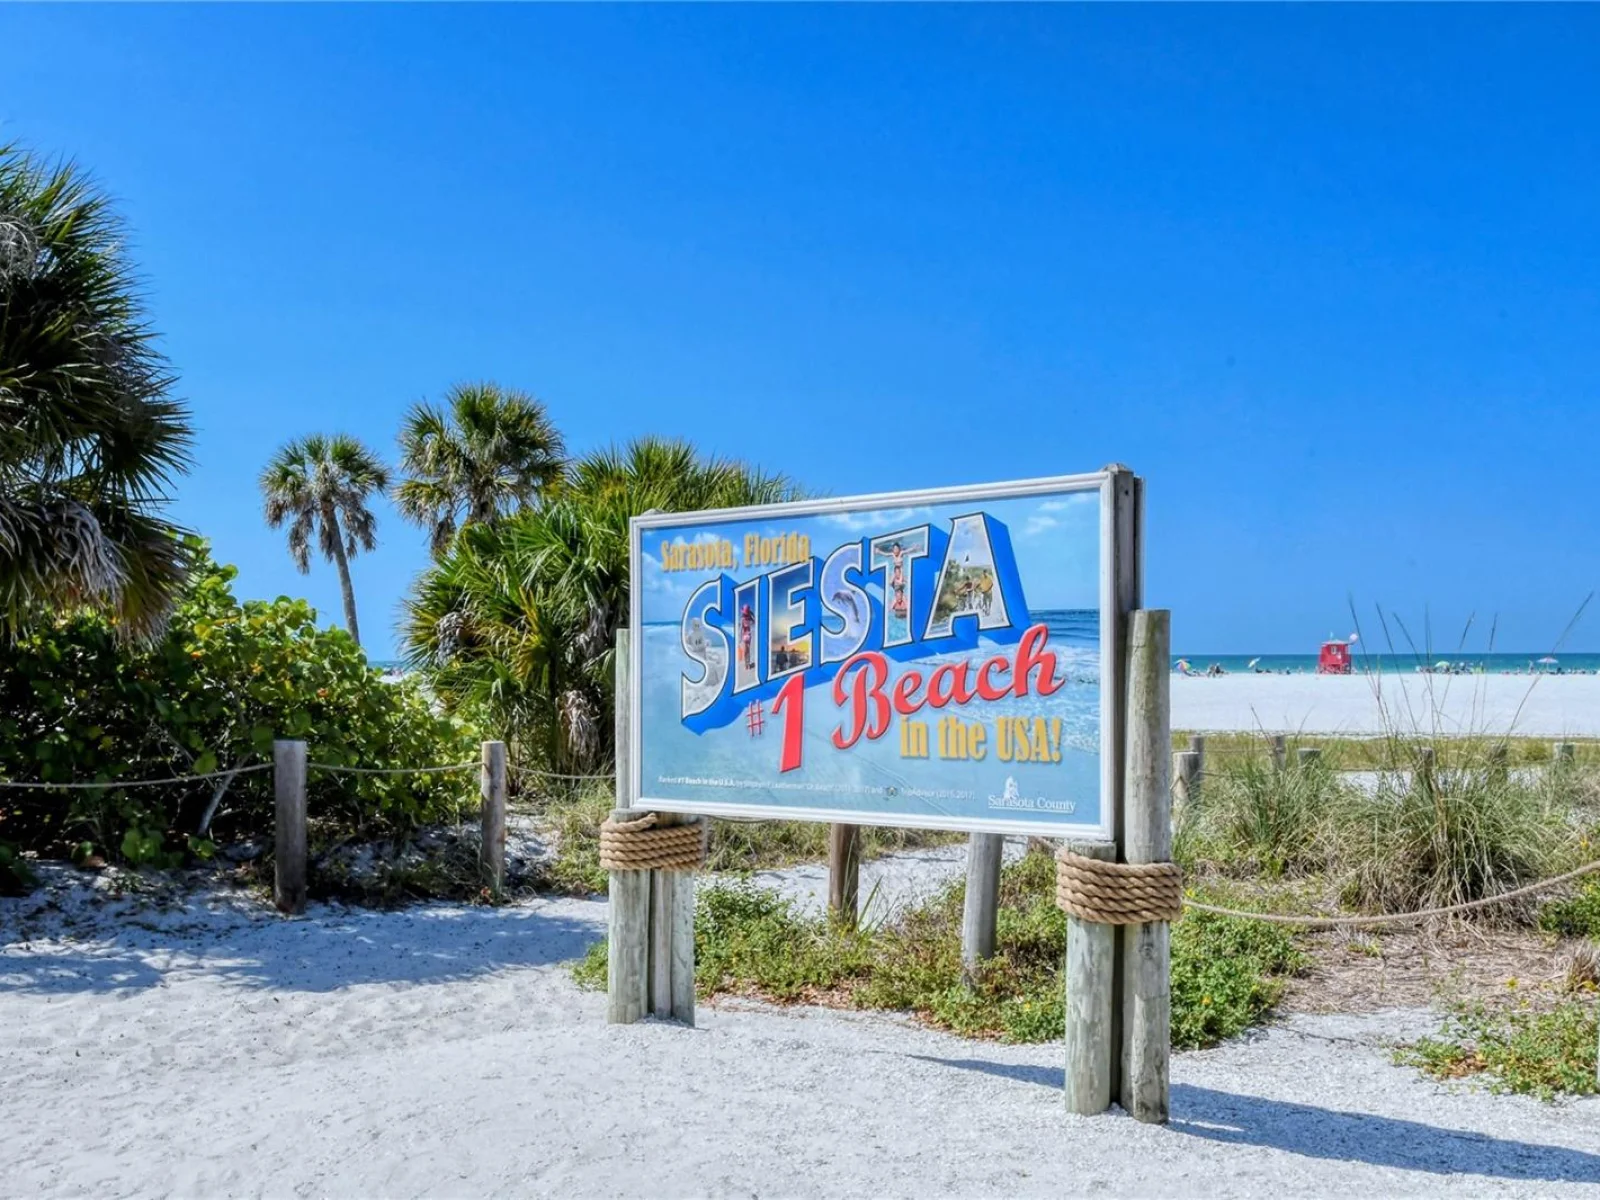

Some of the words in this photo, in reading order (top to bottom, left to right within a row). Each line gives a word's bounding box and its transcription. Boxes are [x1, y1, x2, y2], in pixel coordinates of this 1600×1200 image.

[661, 539, 738, 572] Sarasota,
[744, 531, 811, 567] Florida
[681, 511, 1014, 722] SIESTA
[831, 623, 1066, 750] Beach
[900, 714, 929, 759] in
[938, 715, 987, 762] the
[996, 716, 1063, 764] USA!
[988, 795, 1034, 808] Sarasota
[1037, 797, 1076, 811] County
